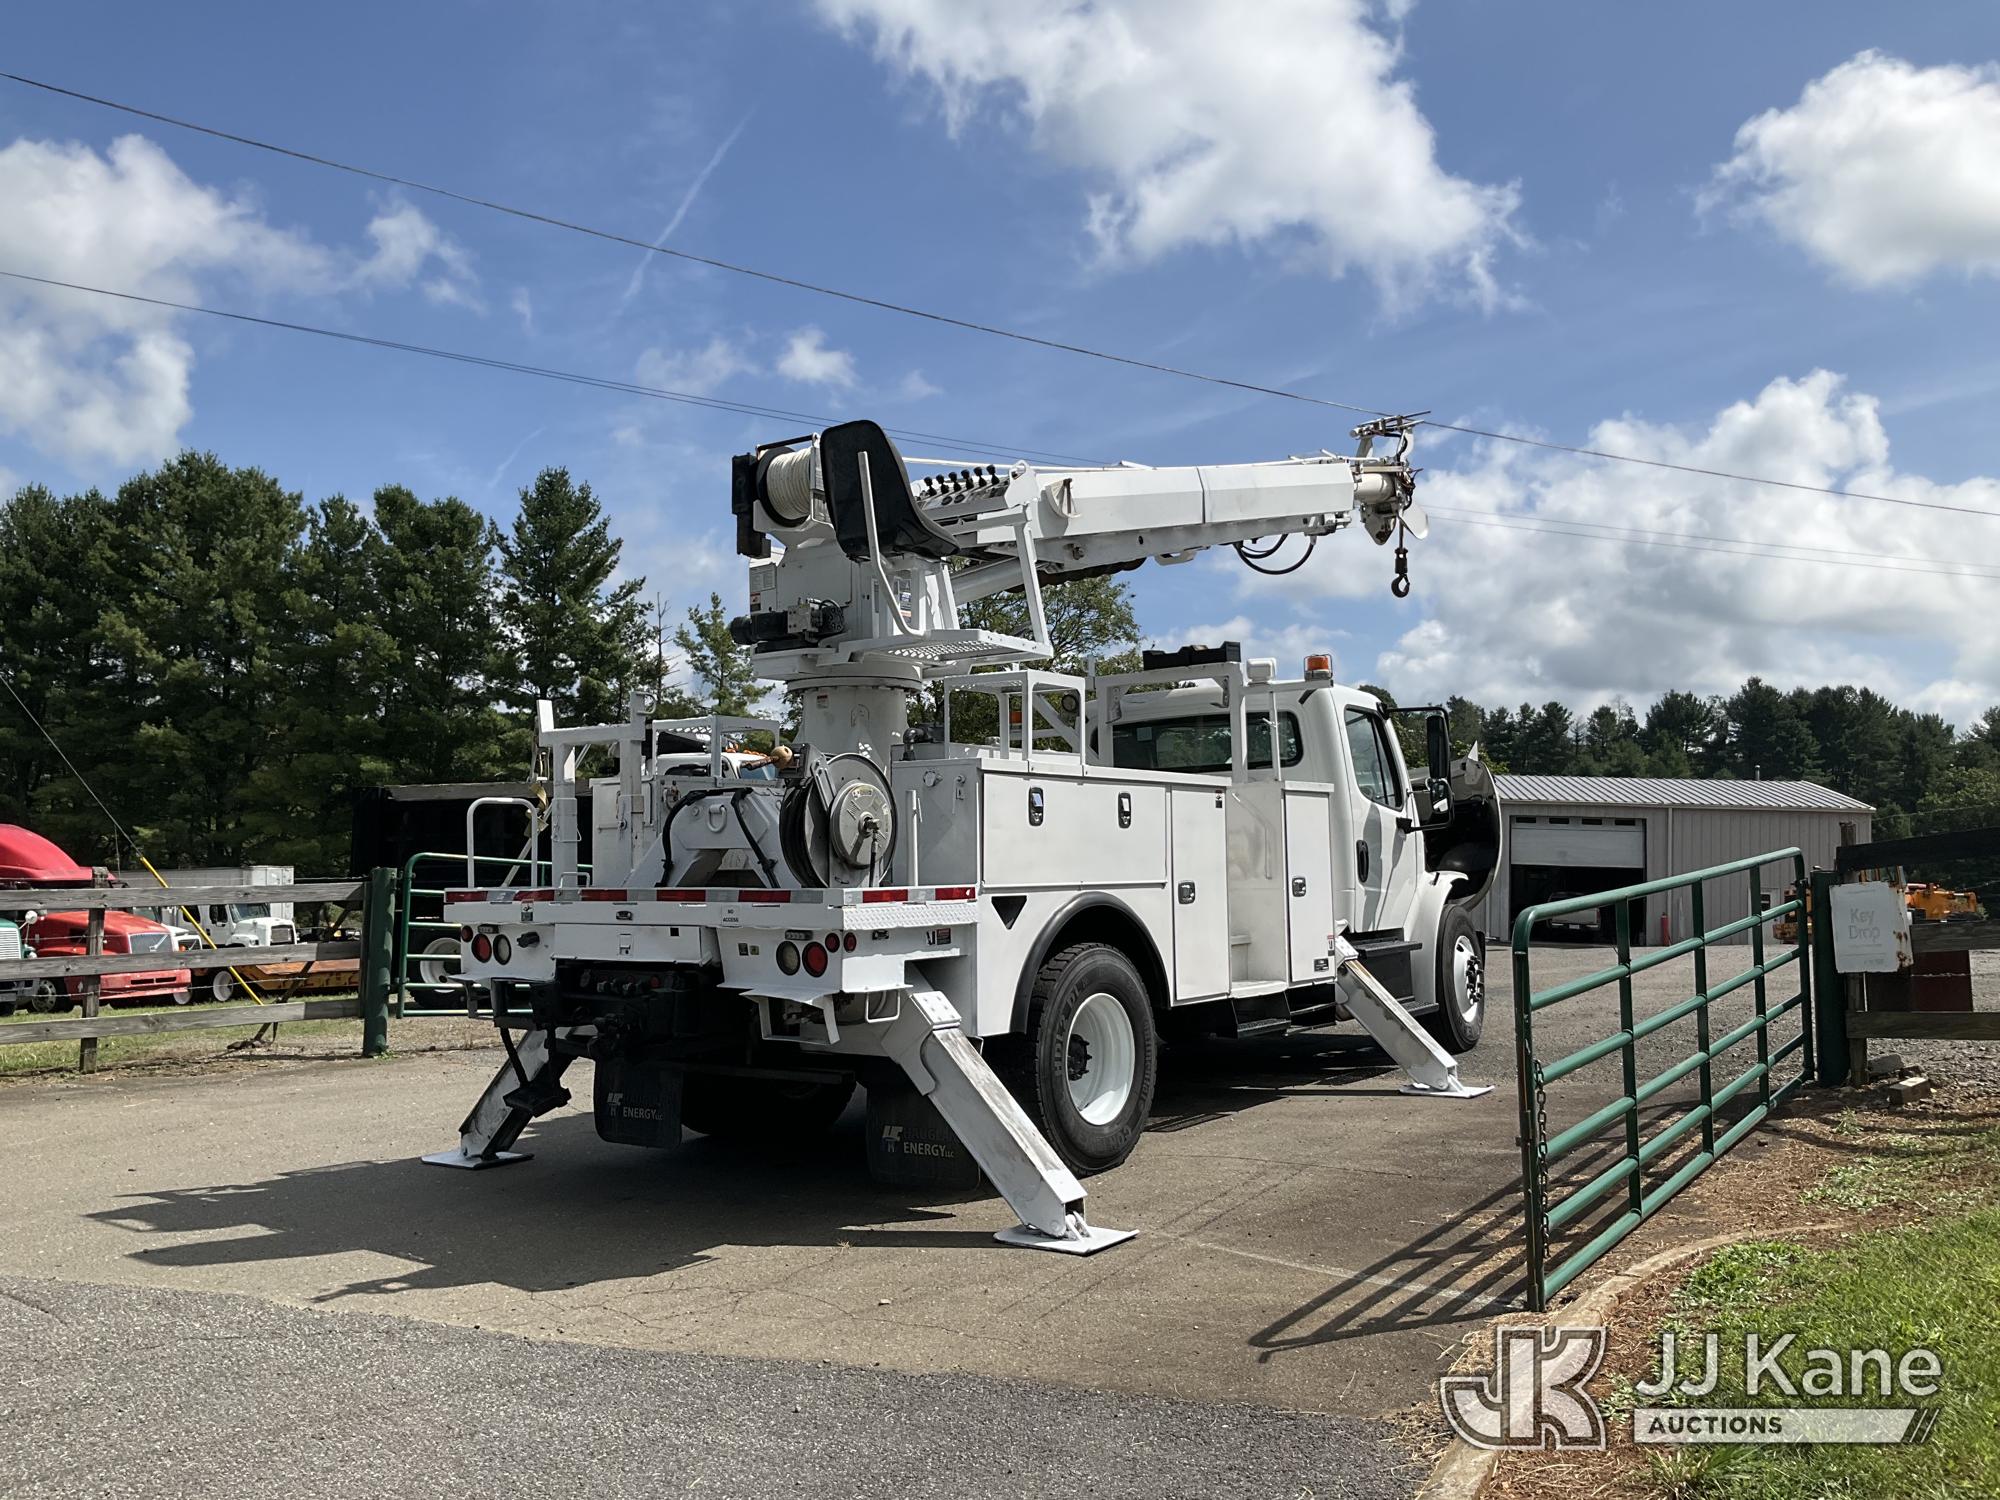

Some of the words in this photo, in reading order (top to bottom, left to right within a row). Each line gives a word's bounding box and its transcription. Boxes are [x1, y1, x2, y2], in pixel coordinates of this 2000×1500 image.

[1850, 908, 1875, 925] Key
[1848, 925, 1880, 943] Drop
[623, 1106, 656, 1120] ENERGY
[903, 1142, 946, 1157] ENERGY
